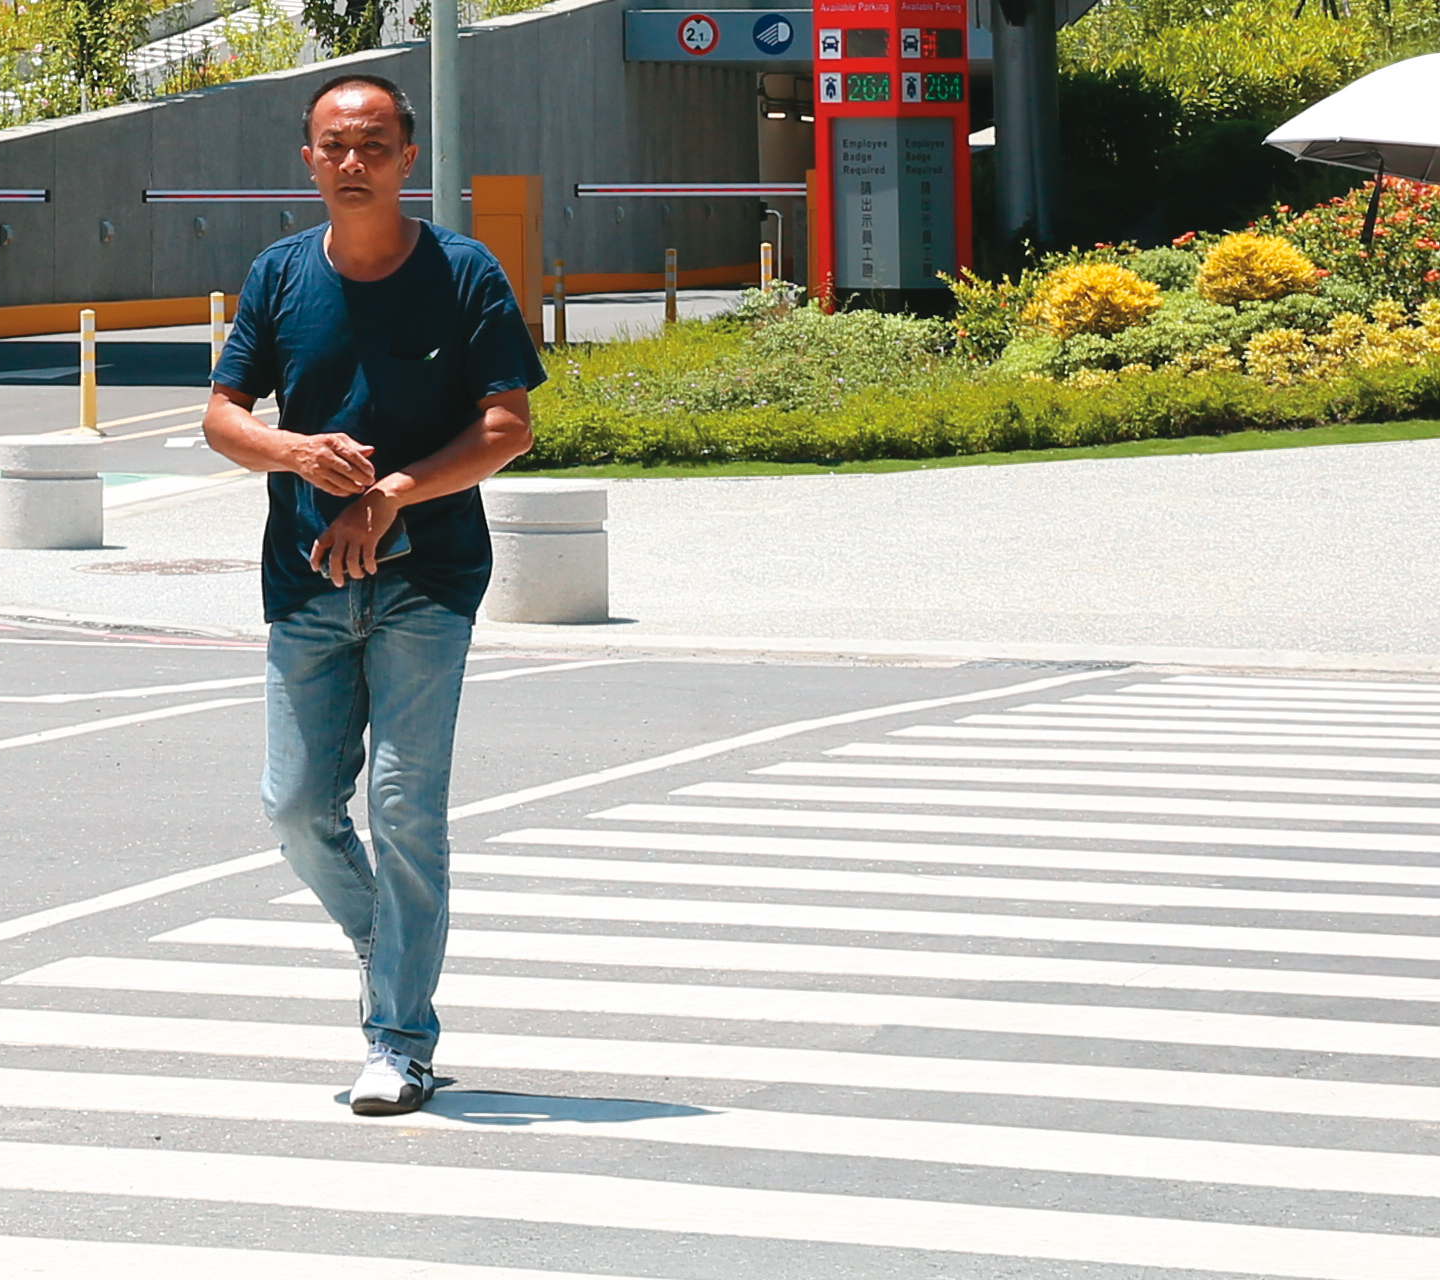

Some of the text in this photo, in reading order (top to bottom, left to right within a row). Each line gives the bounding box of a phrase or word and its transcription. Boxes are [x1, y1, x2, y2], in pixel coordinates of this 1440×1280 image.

[820, 2, 890, 13] Available Parking
[901, 2, 962, 13] Available Parking
[848, 75, 889, 101] 264
[924, 74, 960, 101] 264
[842, 139, 888, 150] Employee
[905, 139, 945, 150] Employee
[842, 152, 872, 163] Badge
[905, 152, 931, 163] Badge
[843, 165, 886, 176] Required
[905, 165, 943, 176] Required
